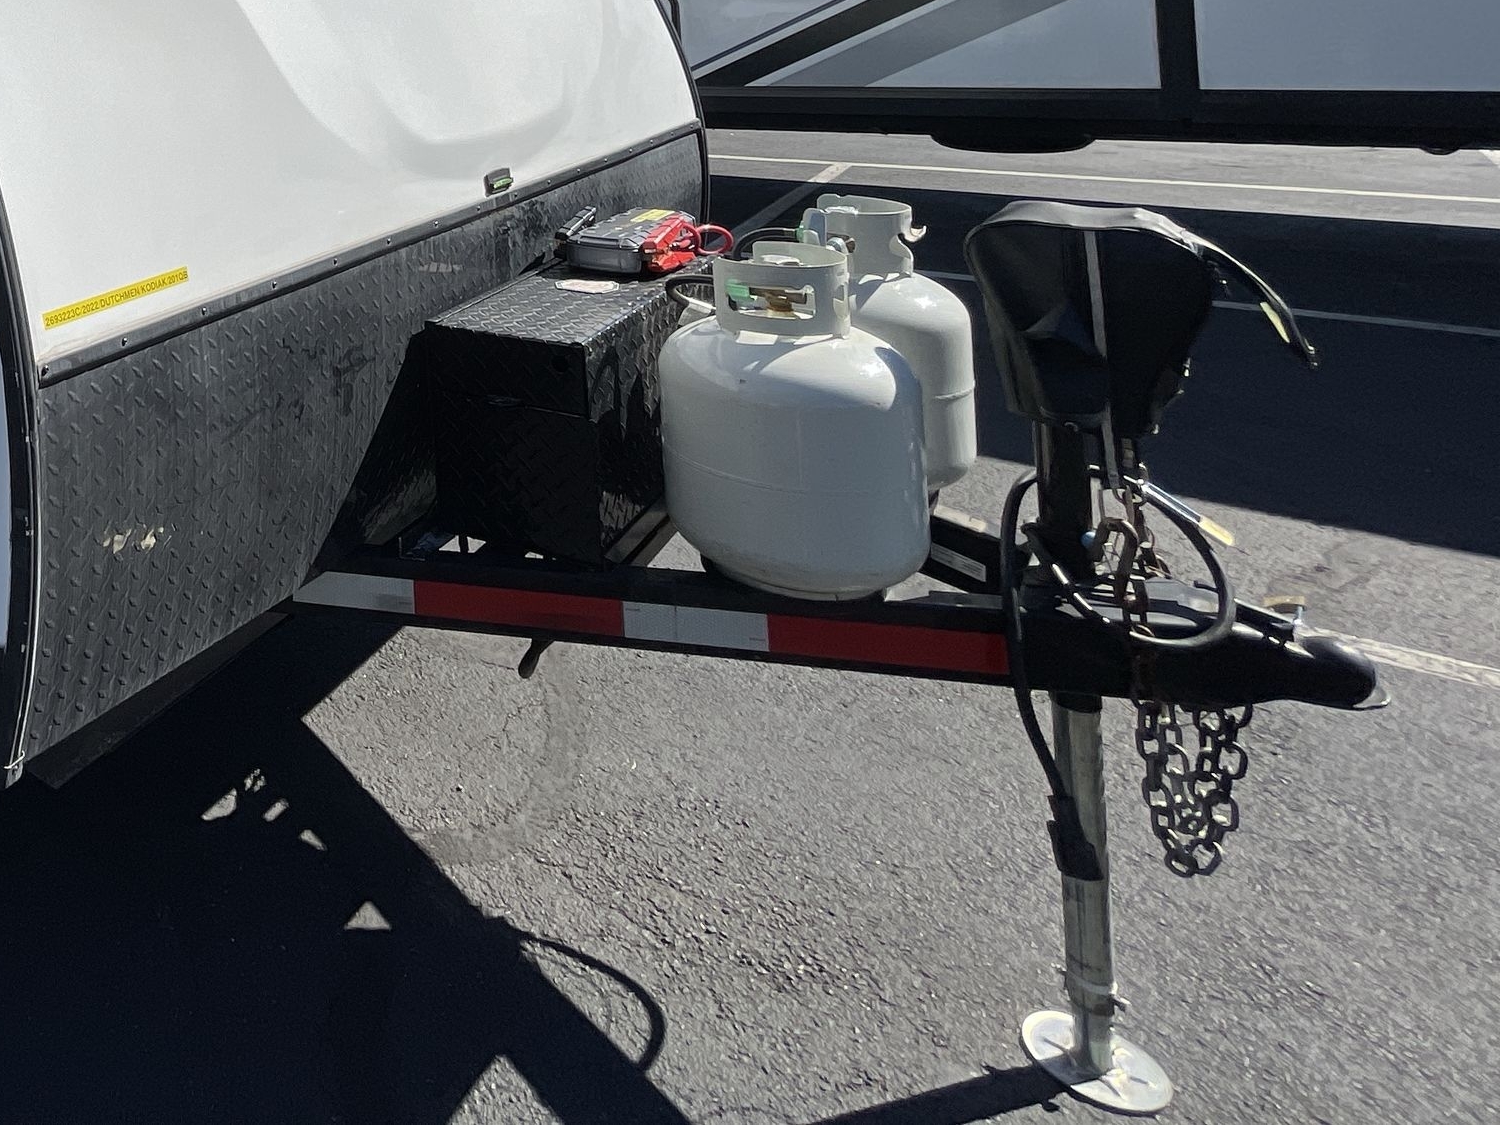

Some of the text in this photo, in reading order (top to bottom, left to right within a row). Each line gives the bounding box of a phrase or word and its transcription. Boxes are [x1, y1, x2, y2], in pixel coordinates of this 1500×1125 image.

[82, 301, 100, 315] 2022
[100, 287, 141, 308] DUTCHMEN
[140, 279, 168, 294] KODIAK
